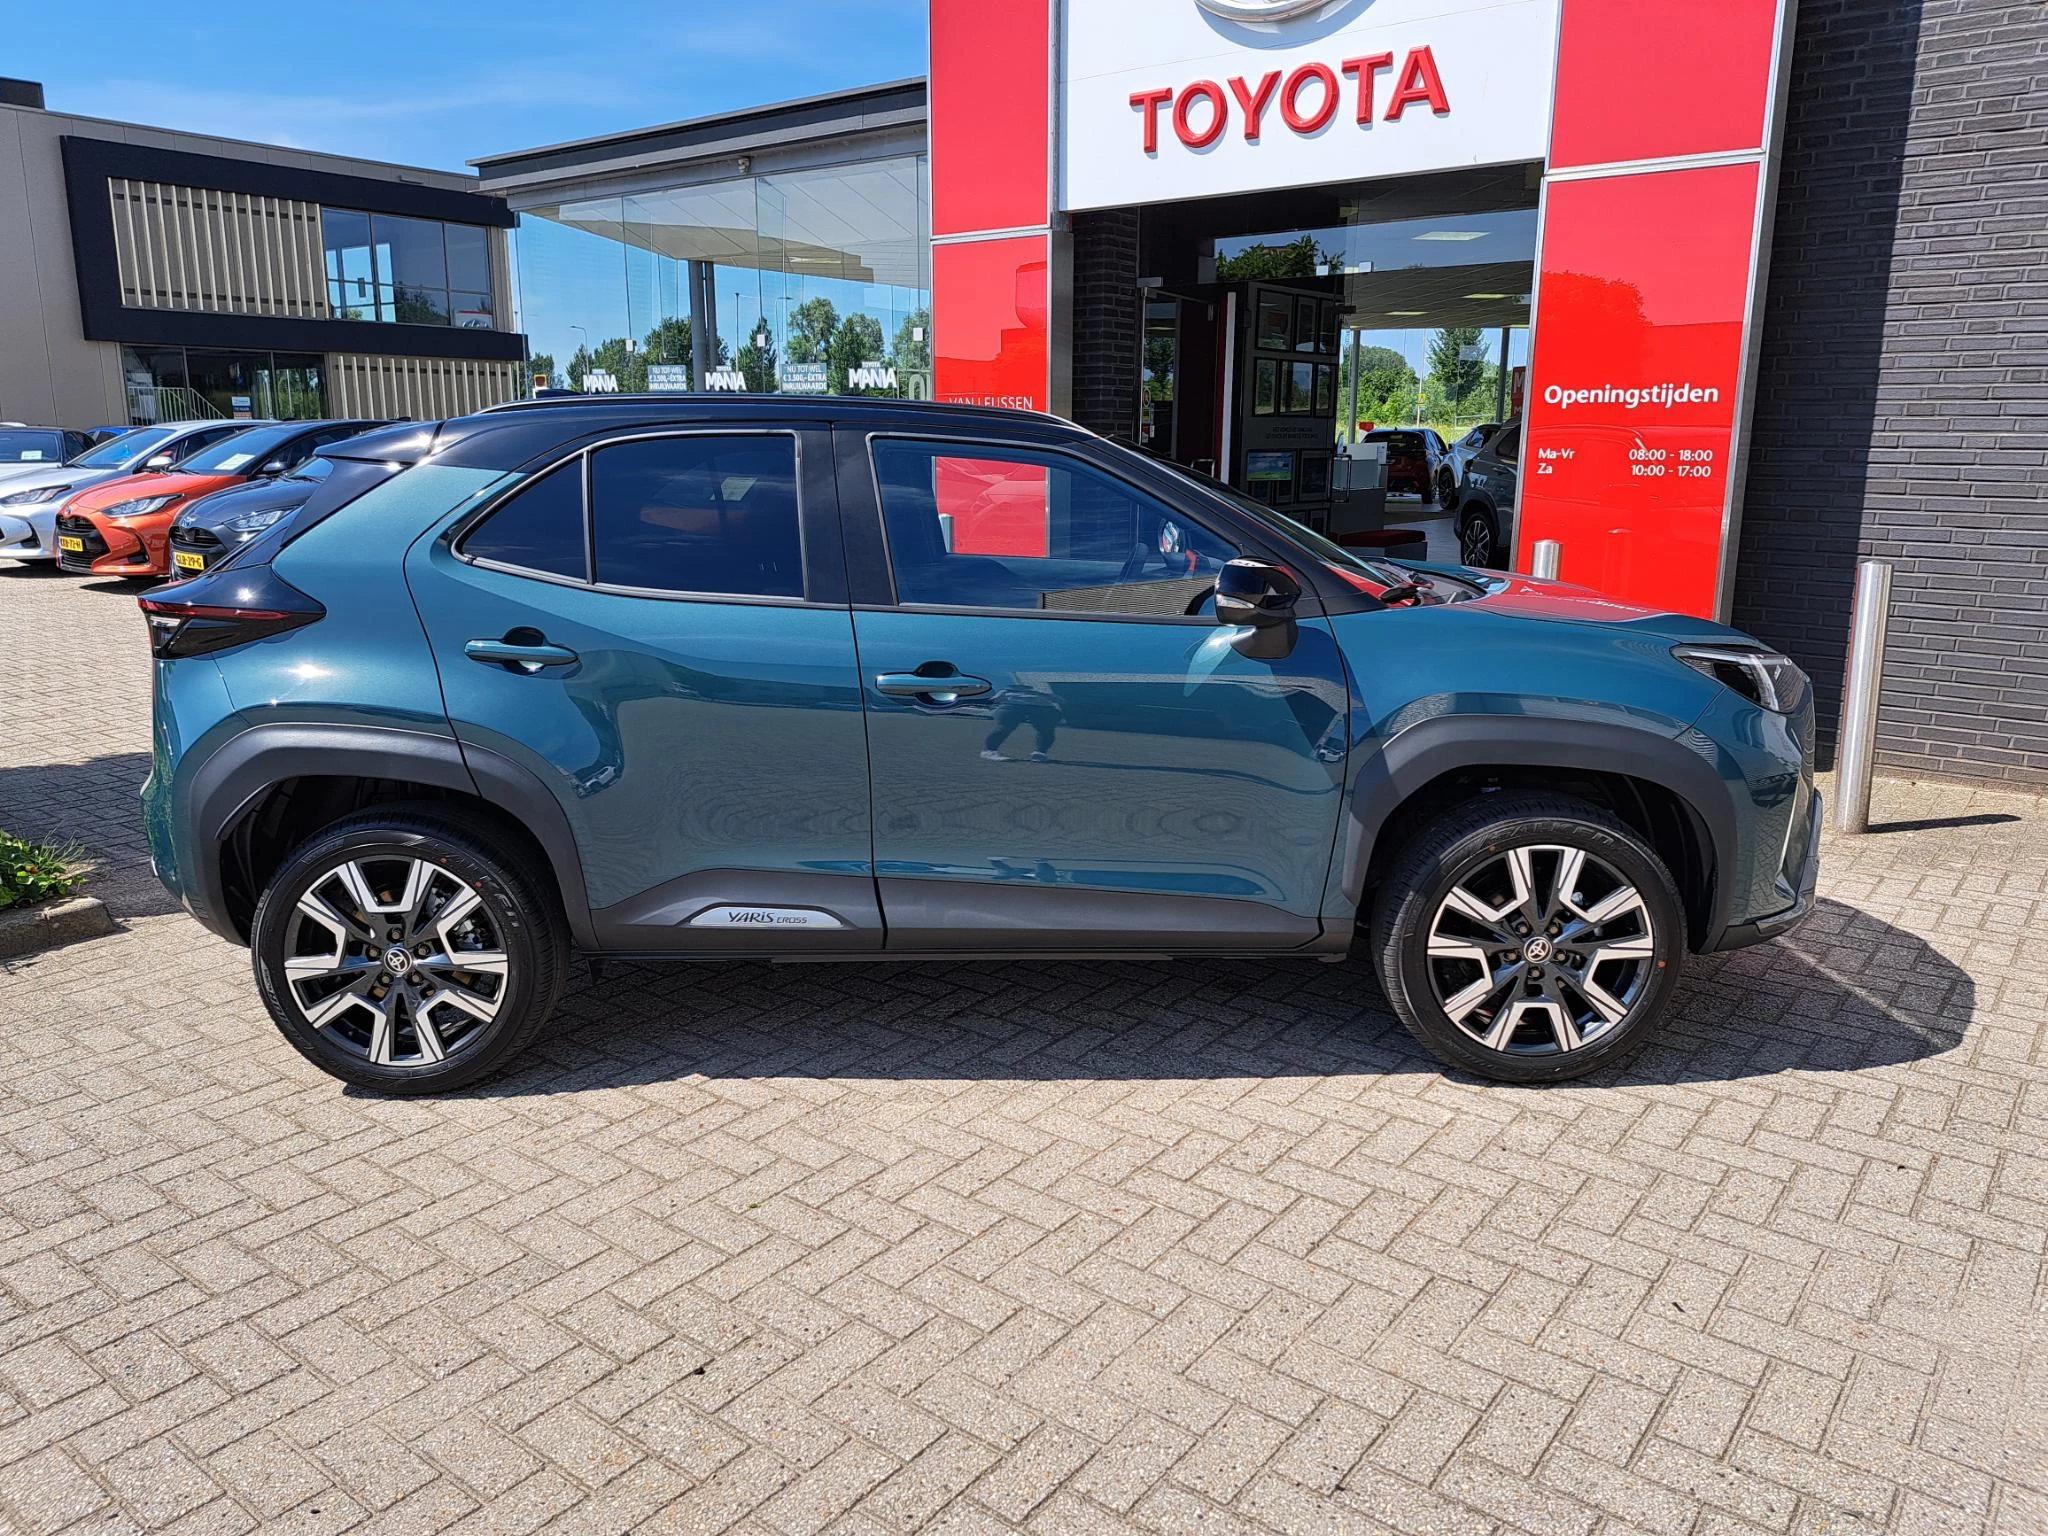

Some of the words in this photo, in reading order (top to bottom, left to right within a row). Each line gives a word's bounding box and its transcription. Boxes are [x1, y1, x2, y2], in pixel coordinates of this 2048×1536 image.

[1129, 44, 1451, 154] TOYOTA
[583, 374, 619, 393] MANIA
[705, 371, 747, 392] MANIA
[849, 367, 897, 390] MANIA
[1544, 383, 1719, 409] Openingstijden
[1538, 448, 1576, 460] Ma-Vr
[1629, 449, 1666, 461] 08:00
[1678, 449, 1713, 462] 18:00
[1537, 463, 1553, 475] Za
[1631, 464, 1665, 476] 10:00
[1677, 465, 1712, 477] 17:00
[776, 916, 808, 924] CROSS
